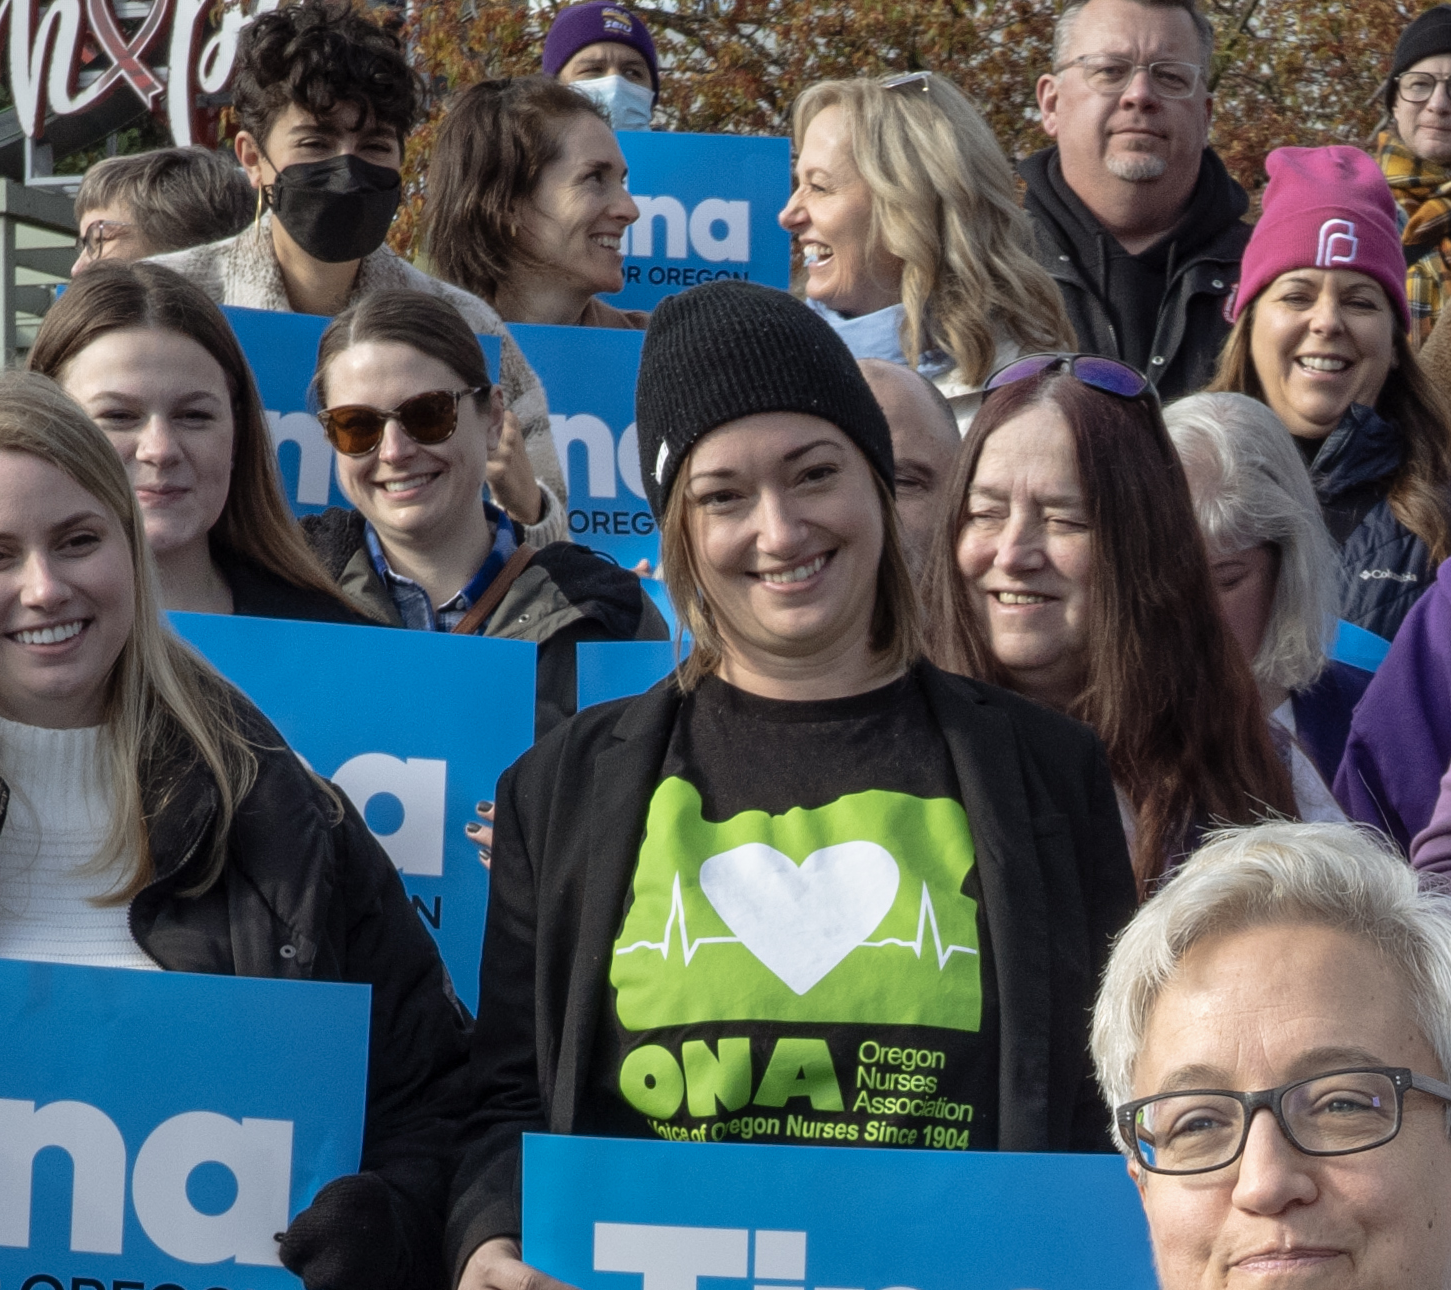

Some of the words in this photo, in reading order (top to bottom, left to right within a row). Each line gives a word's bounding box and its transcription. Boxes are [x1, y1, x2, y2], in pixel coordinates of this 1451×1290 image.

[621, 195, 750, 263] na
[568, 509, 655, 535] OREG
[858, 1041, 945, 1071] Oregon
[620, 1037, 845, 1120] ONA
[856, 1066, 938, 1094] Nurses
[853, 1091, 973, 1123] Association
[711, 1115, 780, 1142] Oregon
[785, 1114, 860, 1141] Nurses
[860, 1120, 918, 1146] Since
[922, 1124, 970, 1150] 1904
